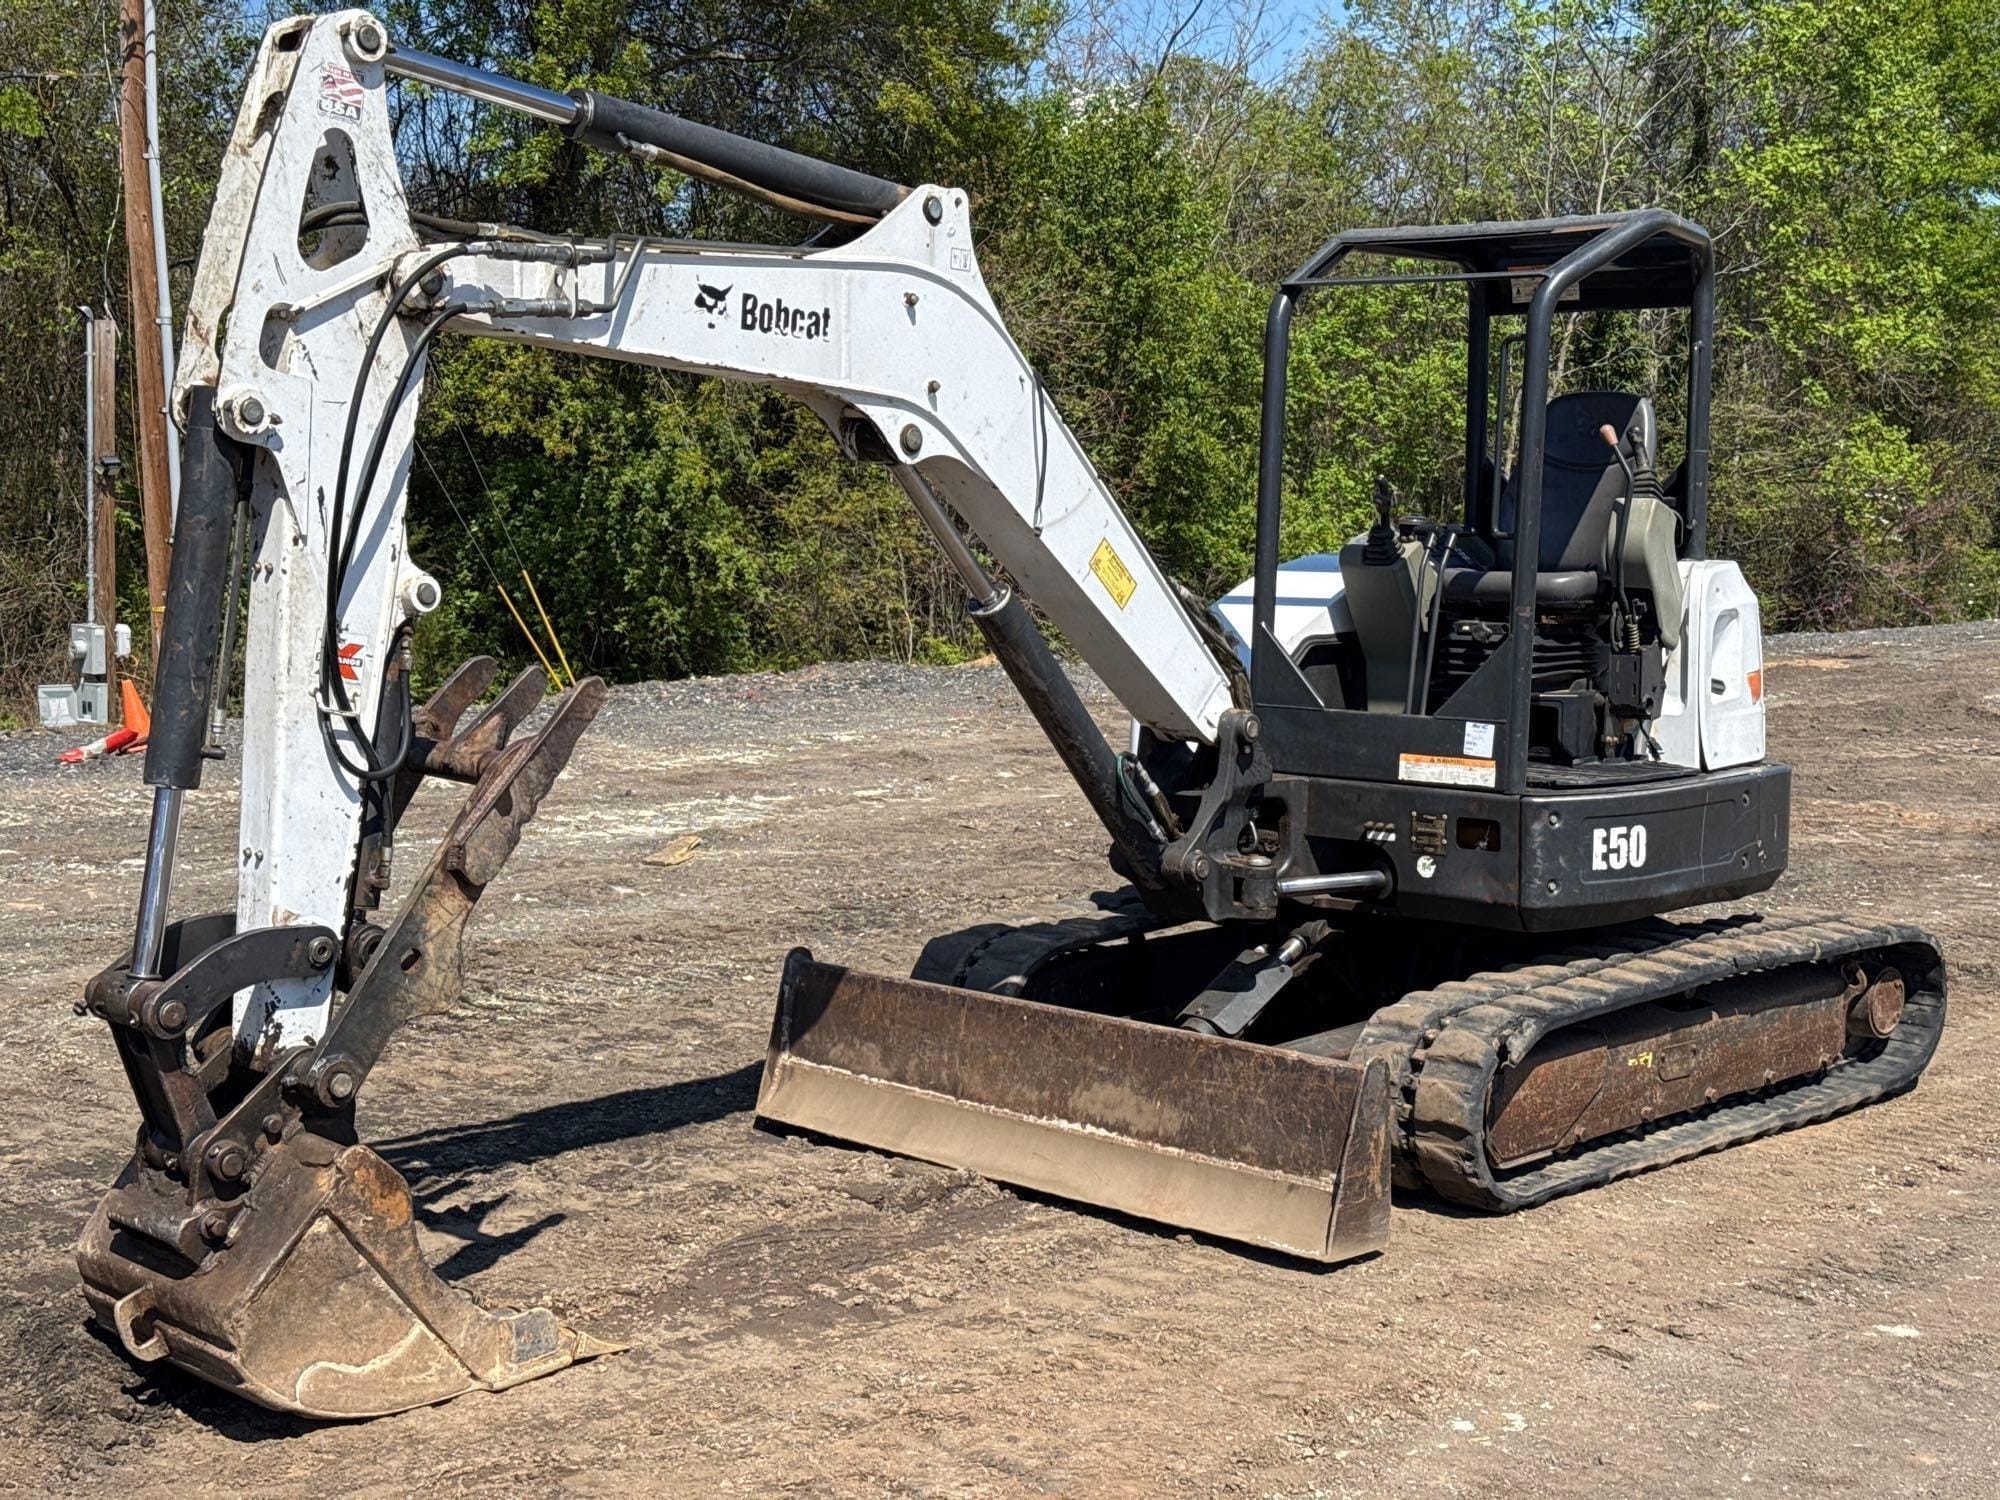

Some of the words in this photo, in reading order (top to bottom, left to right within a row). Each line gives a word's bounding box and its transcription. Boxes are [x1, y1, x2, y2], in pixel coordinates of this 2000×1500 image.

[320, 97, 358, 119] USA
[740, 292, 831, 343] Bobcat
[1592, 824, 1647, 871] E50
